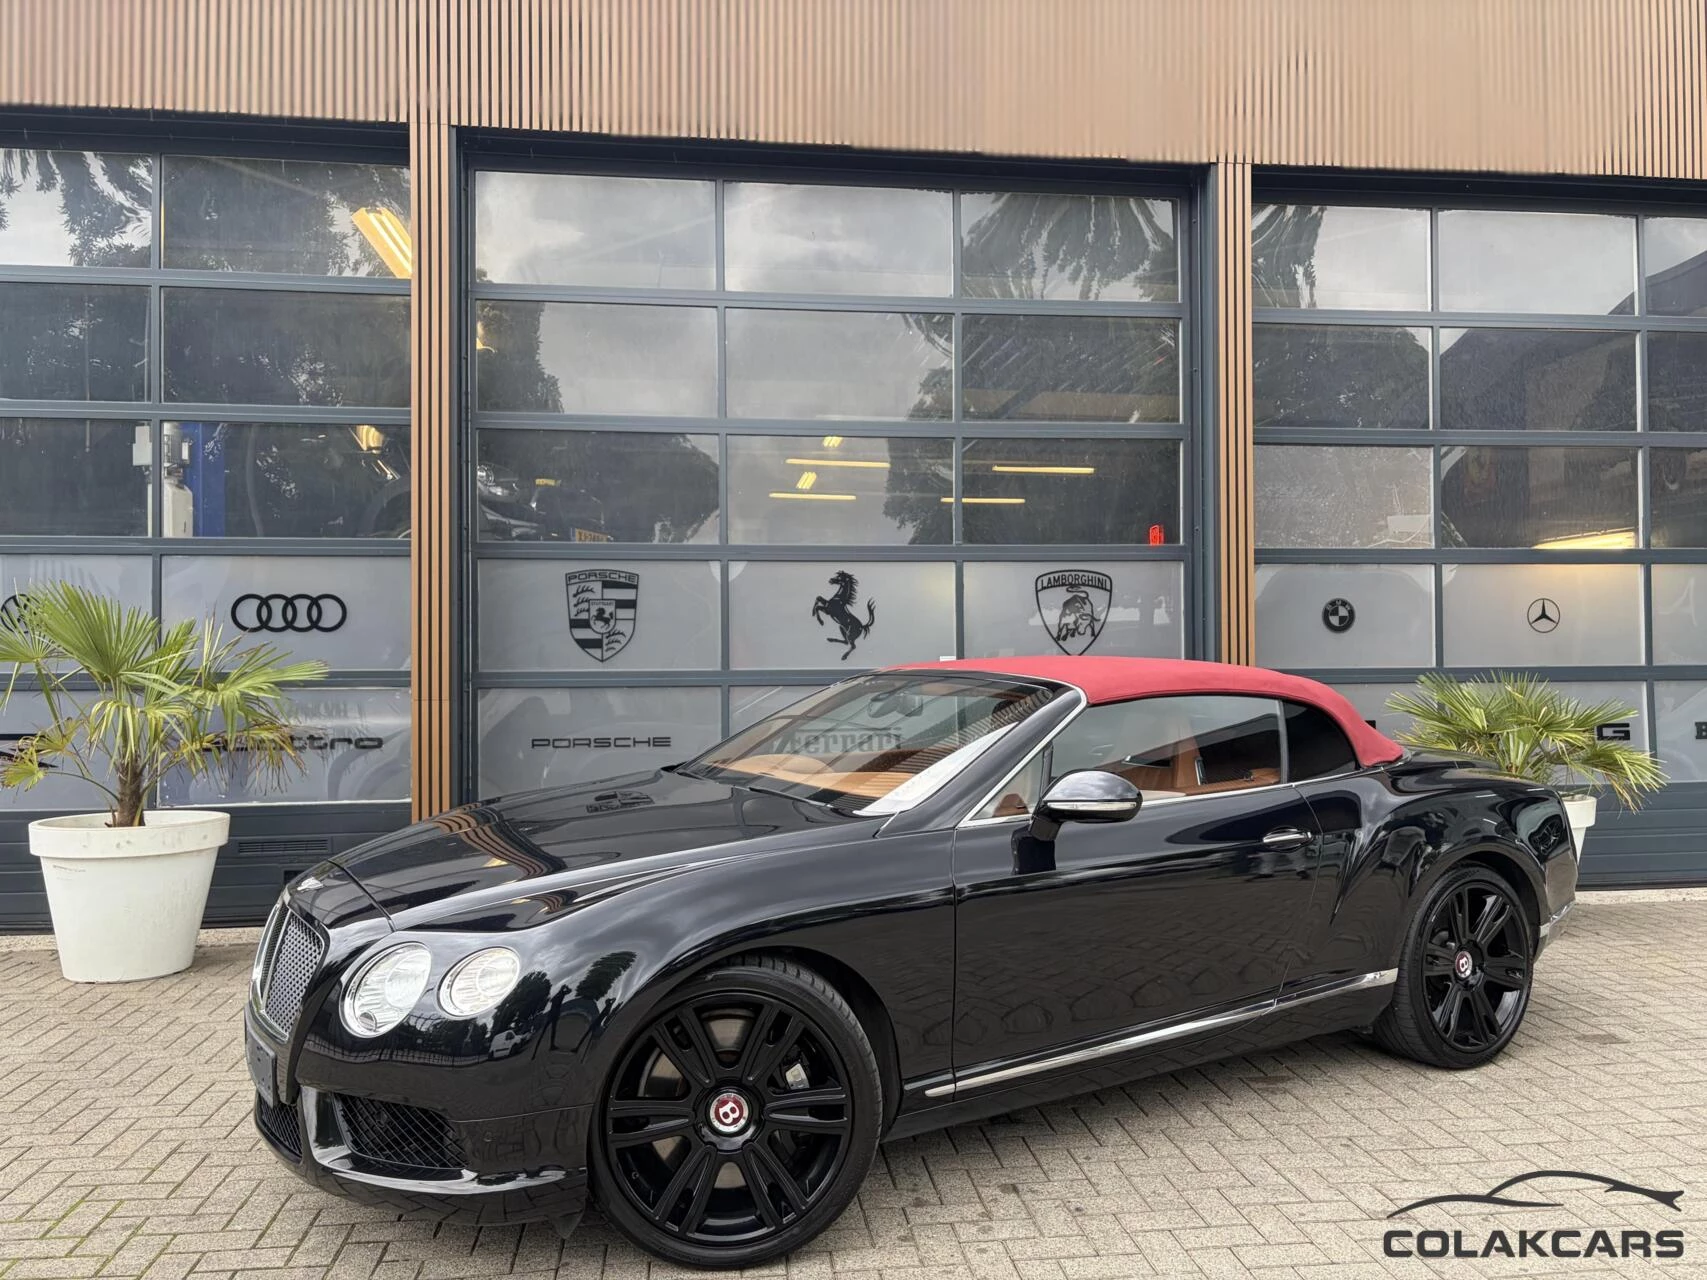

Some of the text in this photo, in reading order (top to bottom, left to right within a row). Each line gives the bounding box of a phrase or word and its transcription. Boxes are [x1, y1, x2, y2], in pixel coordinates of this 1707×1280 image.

[567, 572, 636, 582] PORSCHE
[1040, 573, 1107, 591] LAMBORGHINI
[531, 736, 671, 749] PORSCHE
